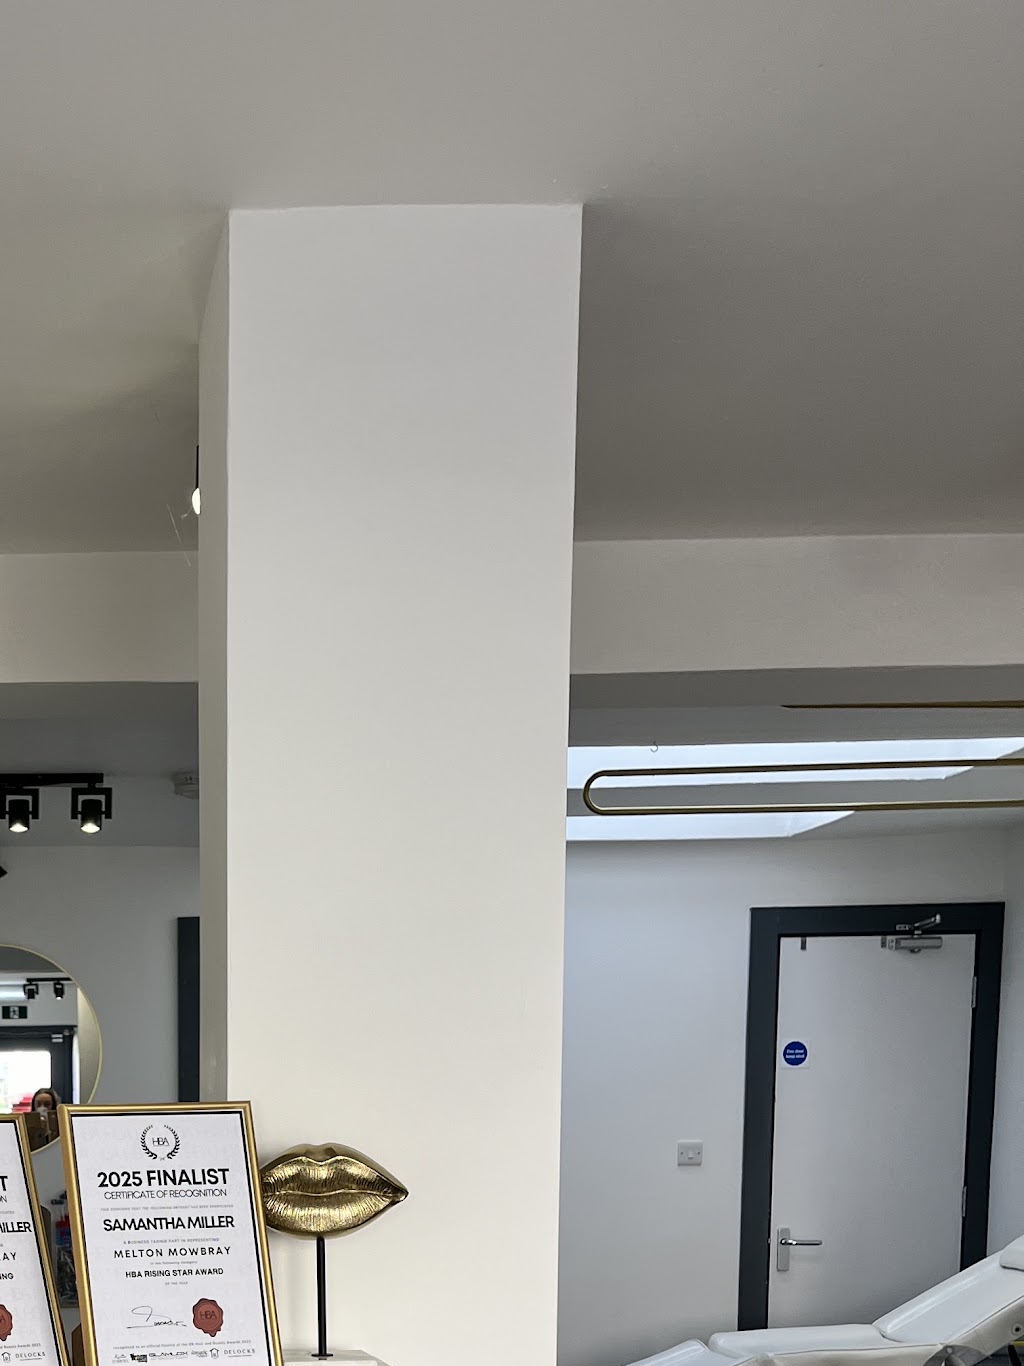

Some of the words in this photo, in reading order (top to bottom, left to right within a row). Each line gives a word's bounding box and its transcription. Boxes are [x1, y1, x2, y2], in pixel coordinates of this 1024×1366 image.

[152, 1137, 169, 1146] HBA
[97, 1171, 142, 1188] 2025
[146, 1169, 229, 1186] FINALIST
[104, 1190, 155, 1200] CERTIFICATE
[156, 1190, 168, 1198] OF
[170, 1189, 227, 1197] RECOGNITION
[103, 1217, 185, 1231] SAMANTHA
[188, 1216, 235, 1228] MILLER
[114, 1248, 163, 1259] MELTON
[168, 1246, 231, 1257] MOWBRAY
[195, 1268, 224, 1276] AWARD
[200, 1311, 216, 1319] HBA
